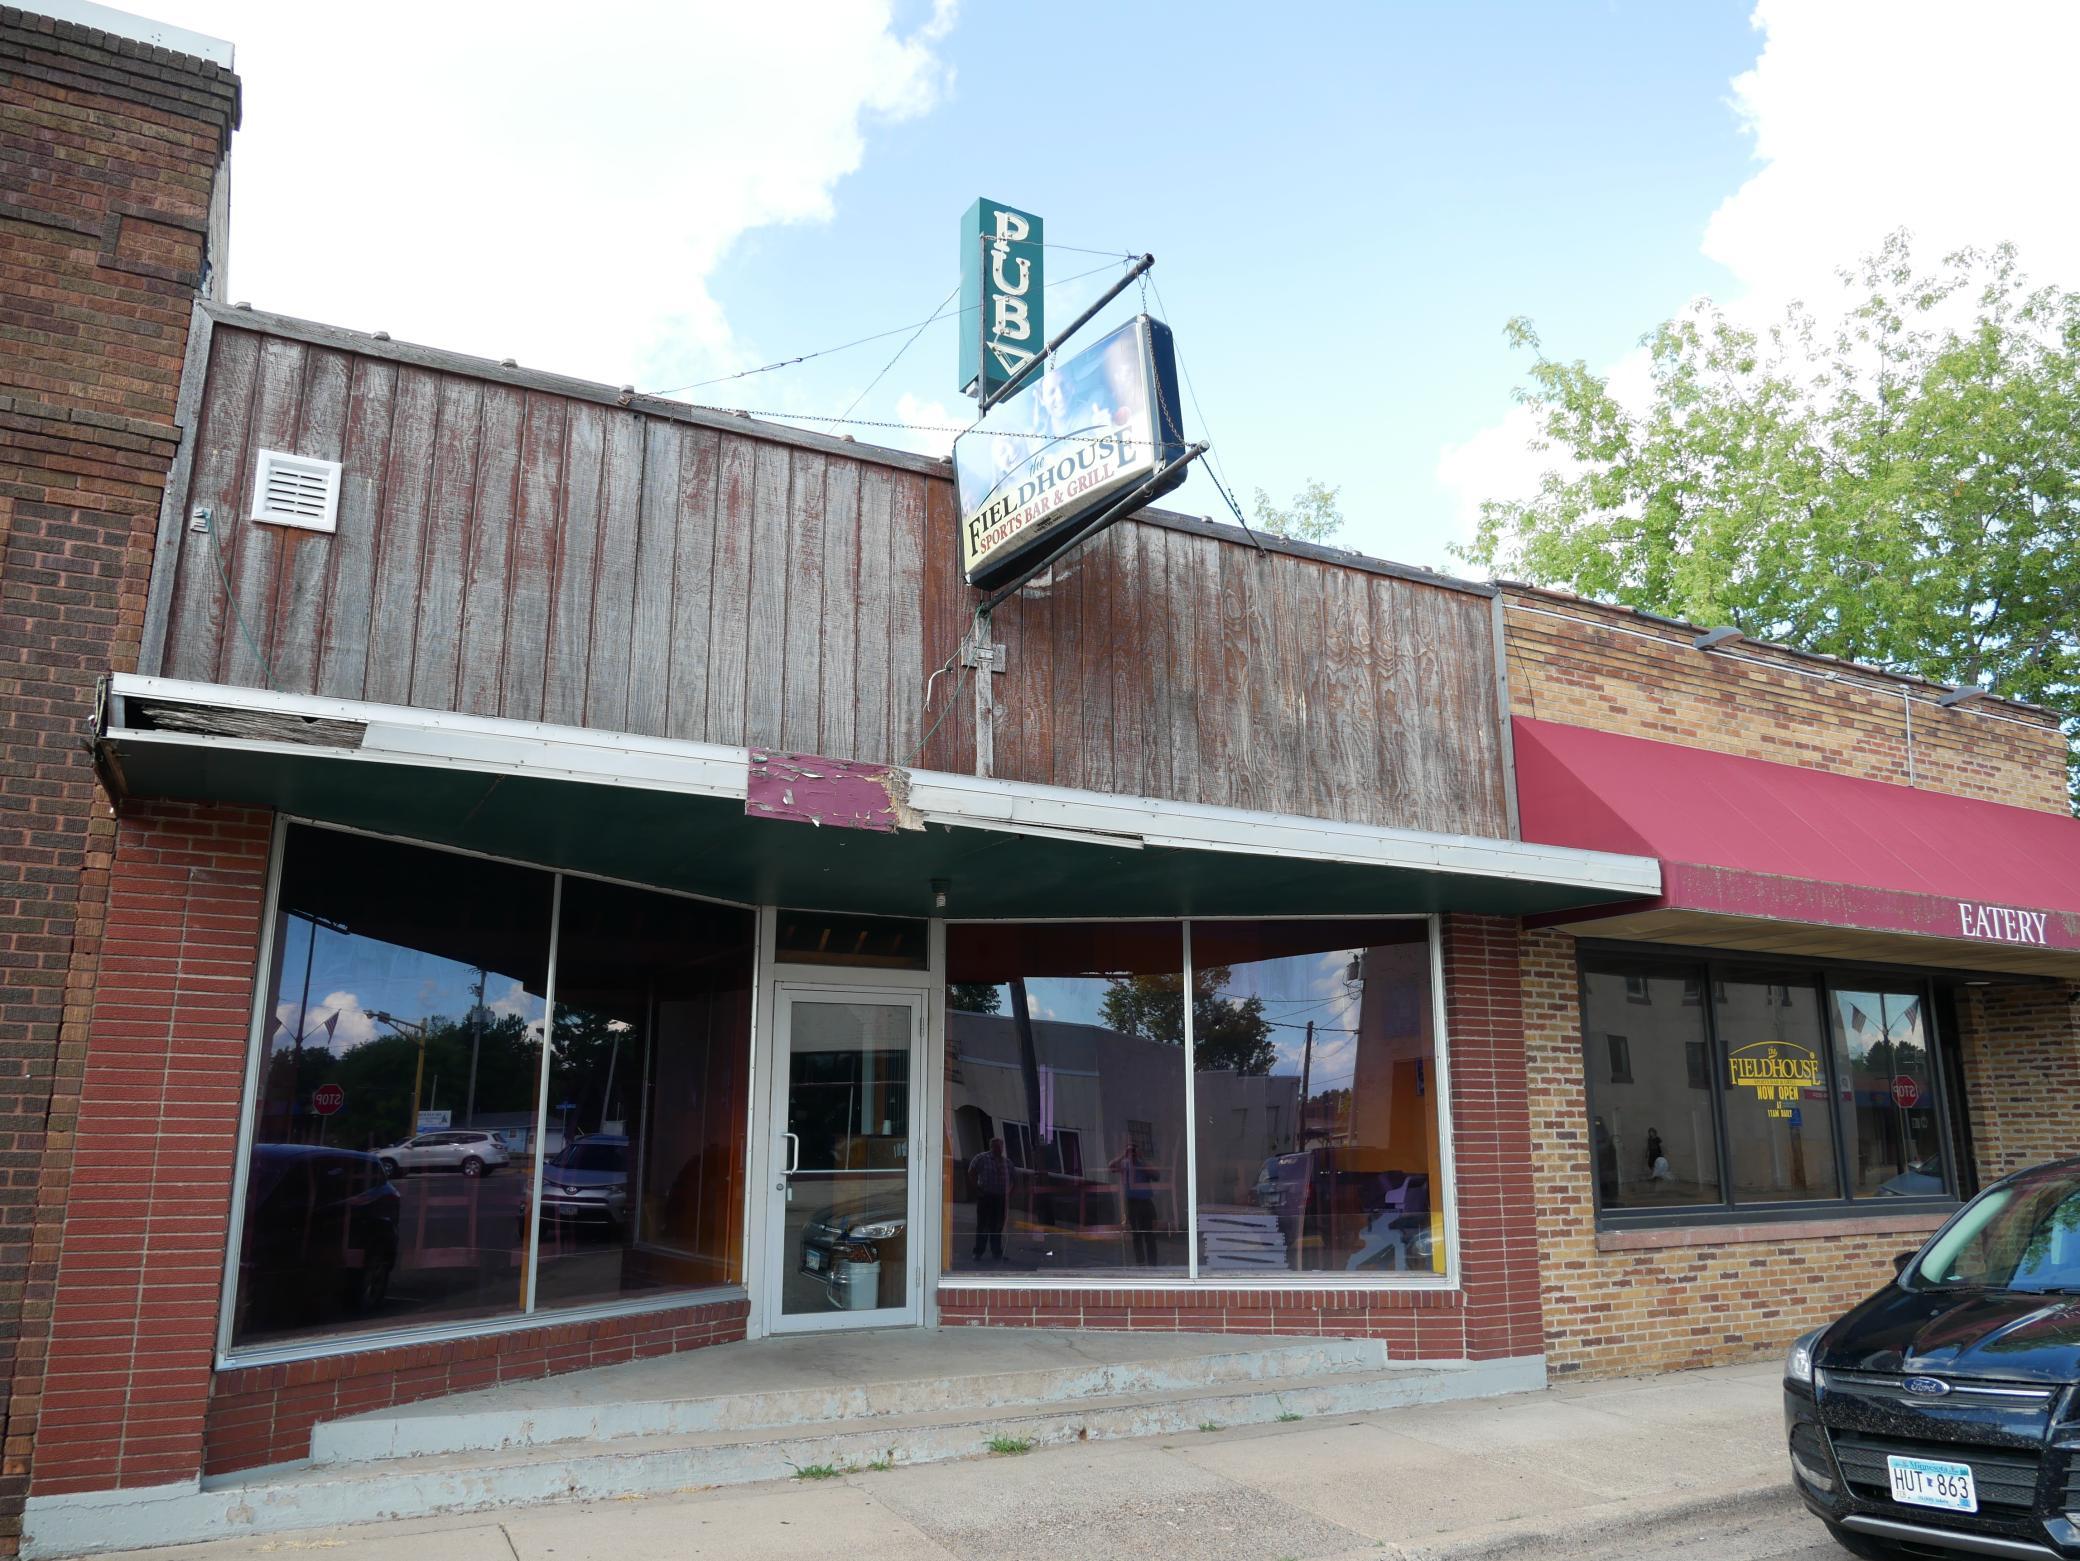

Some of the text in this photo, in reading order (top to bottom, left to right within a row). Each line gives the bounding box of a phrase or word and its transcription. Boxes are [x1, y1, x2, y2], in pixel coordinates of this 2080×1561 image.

[991, 211, 1031, 340] PUB
[1029, 455, 1045, 478] the
[968, 425, 1137, 557] FIELDHOUSE
[980, 513, 1023, 554] SPORTS
[1024, 496, 1050, 525] BAR
[1053, 489, 1064, 506] &
[1066, 463, 1115, 498] GRILL
[1958, 903, 2047, 944] EATERY
[1729, 1058, 1821, 1085] FIELDHOUSE
[1757, 1085, 1775, 1100] NOW
[1778, 1086, 1799, 1100] OPEN
[1894, 1468, 1969, 1499] HUT 863
